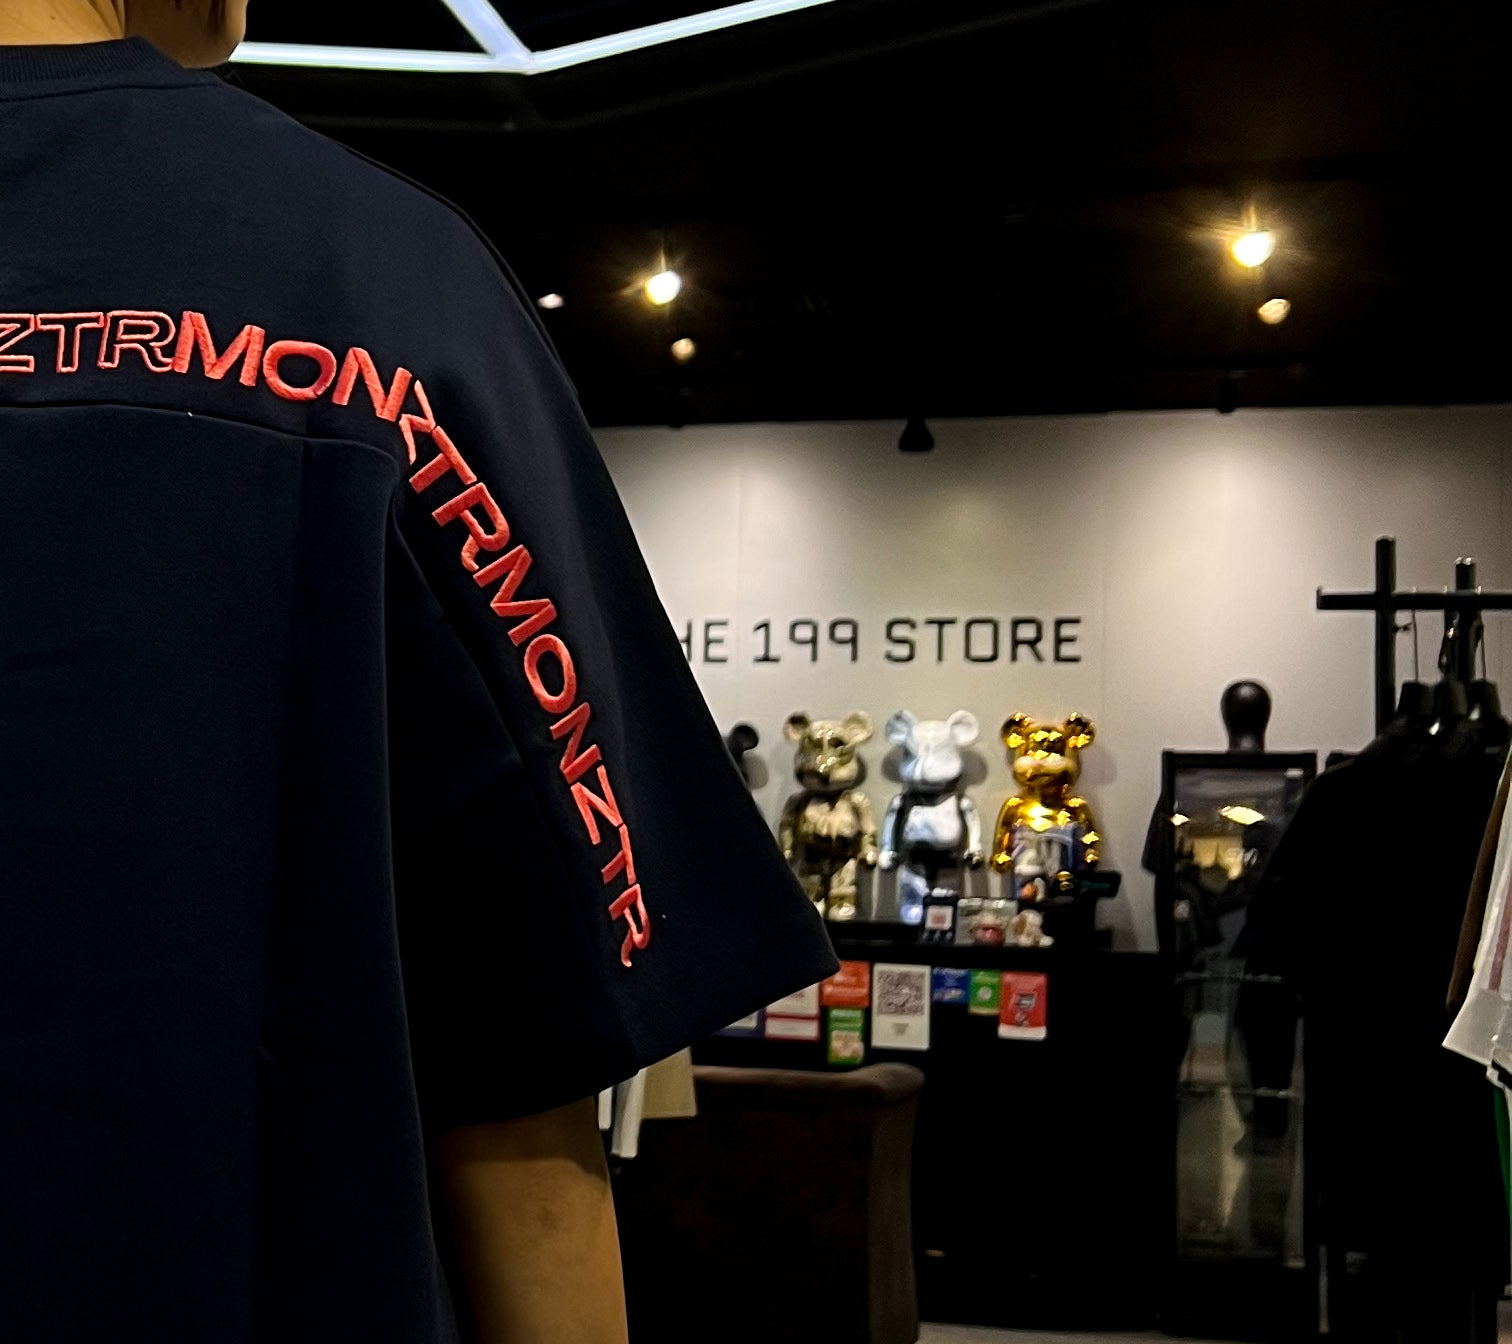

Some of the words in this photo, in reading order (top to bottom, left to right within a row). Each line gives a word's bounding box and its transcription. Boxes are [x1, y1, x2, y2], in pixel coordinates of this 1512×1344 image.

[172, 309, 510, 572] MONZTR
[473, 543, 651, 968] MONZTR
[751, 618, 859, 663] 199
[884, 617, 1082, 663] STORE
